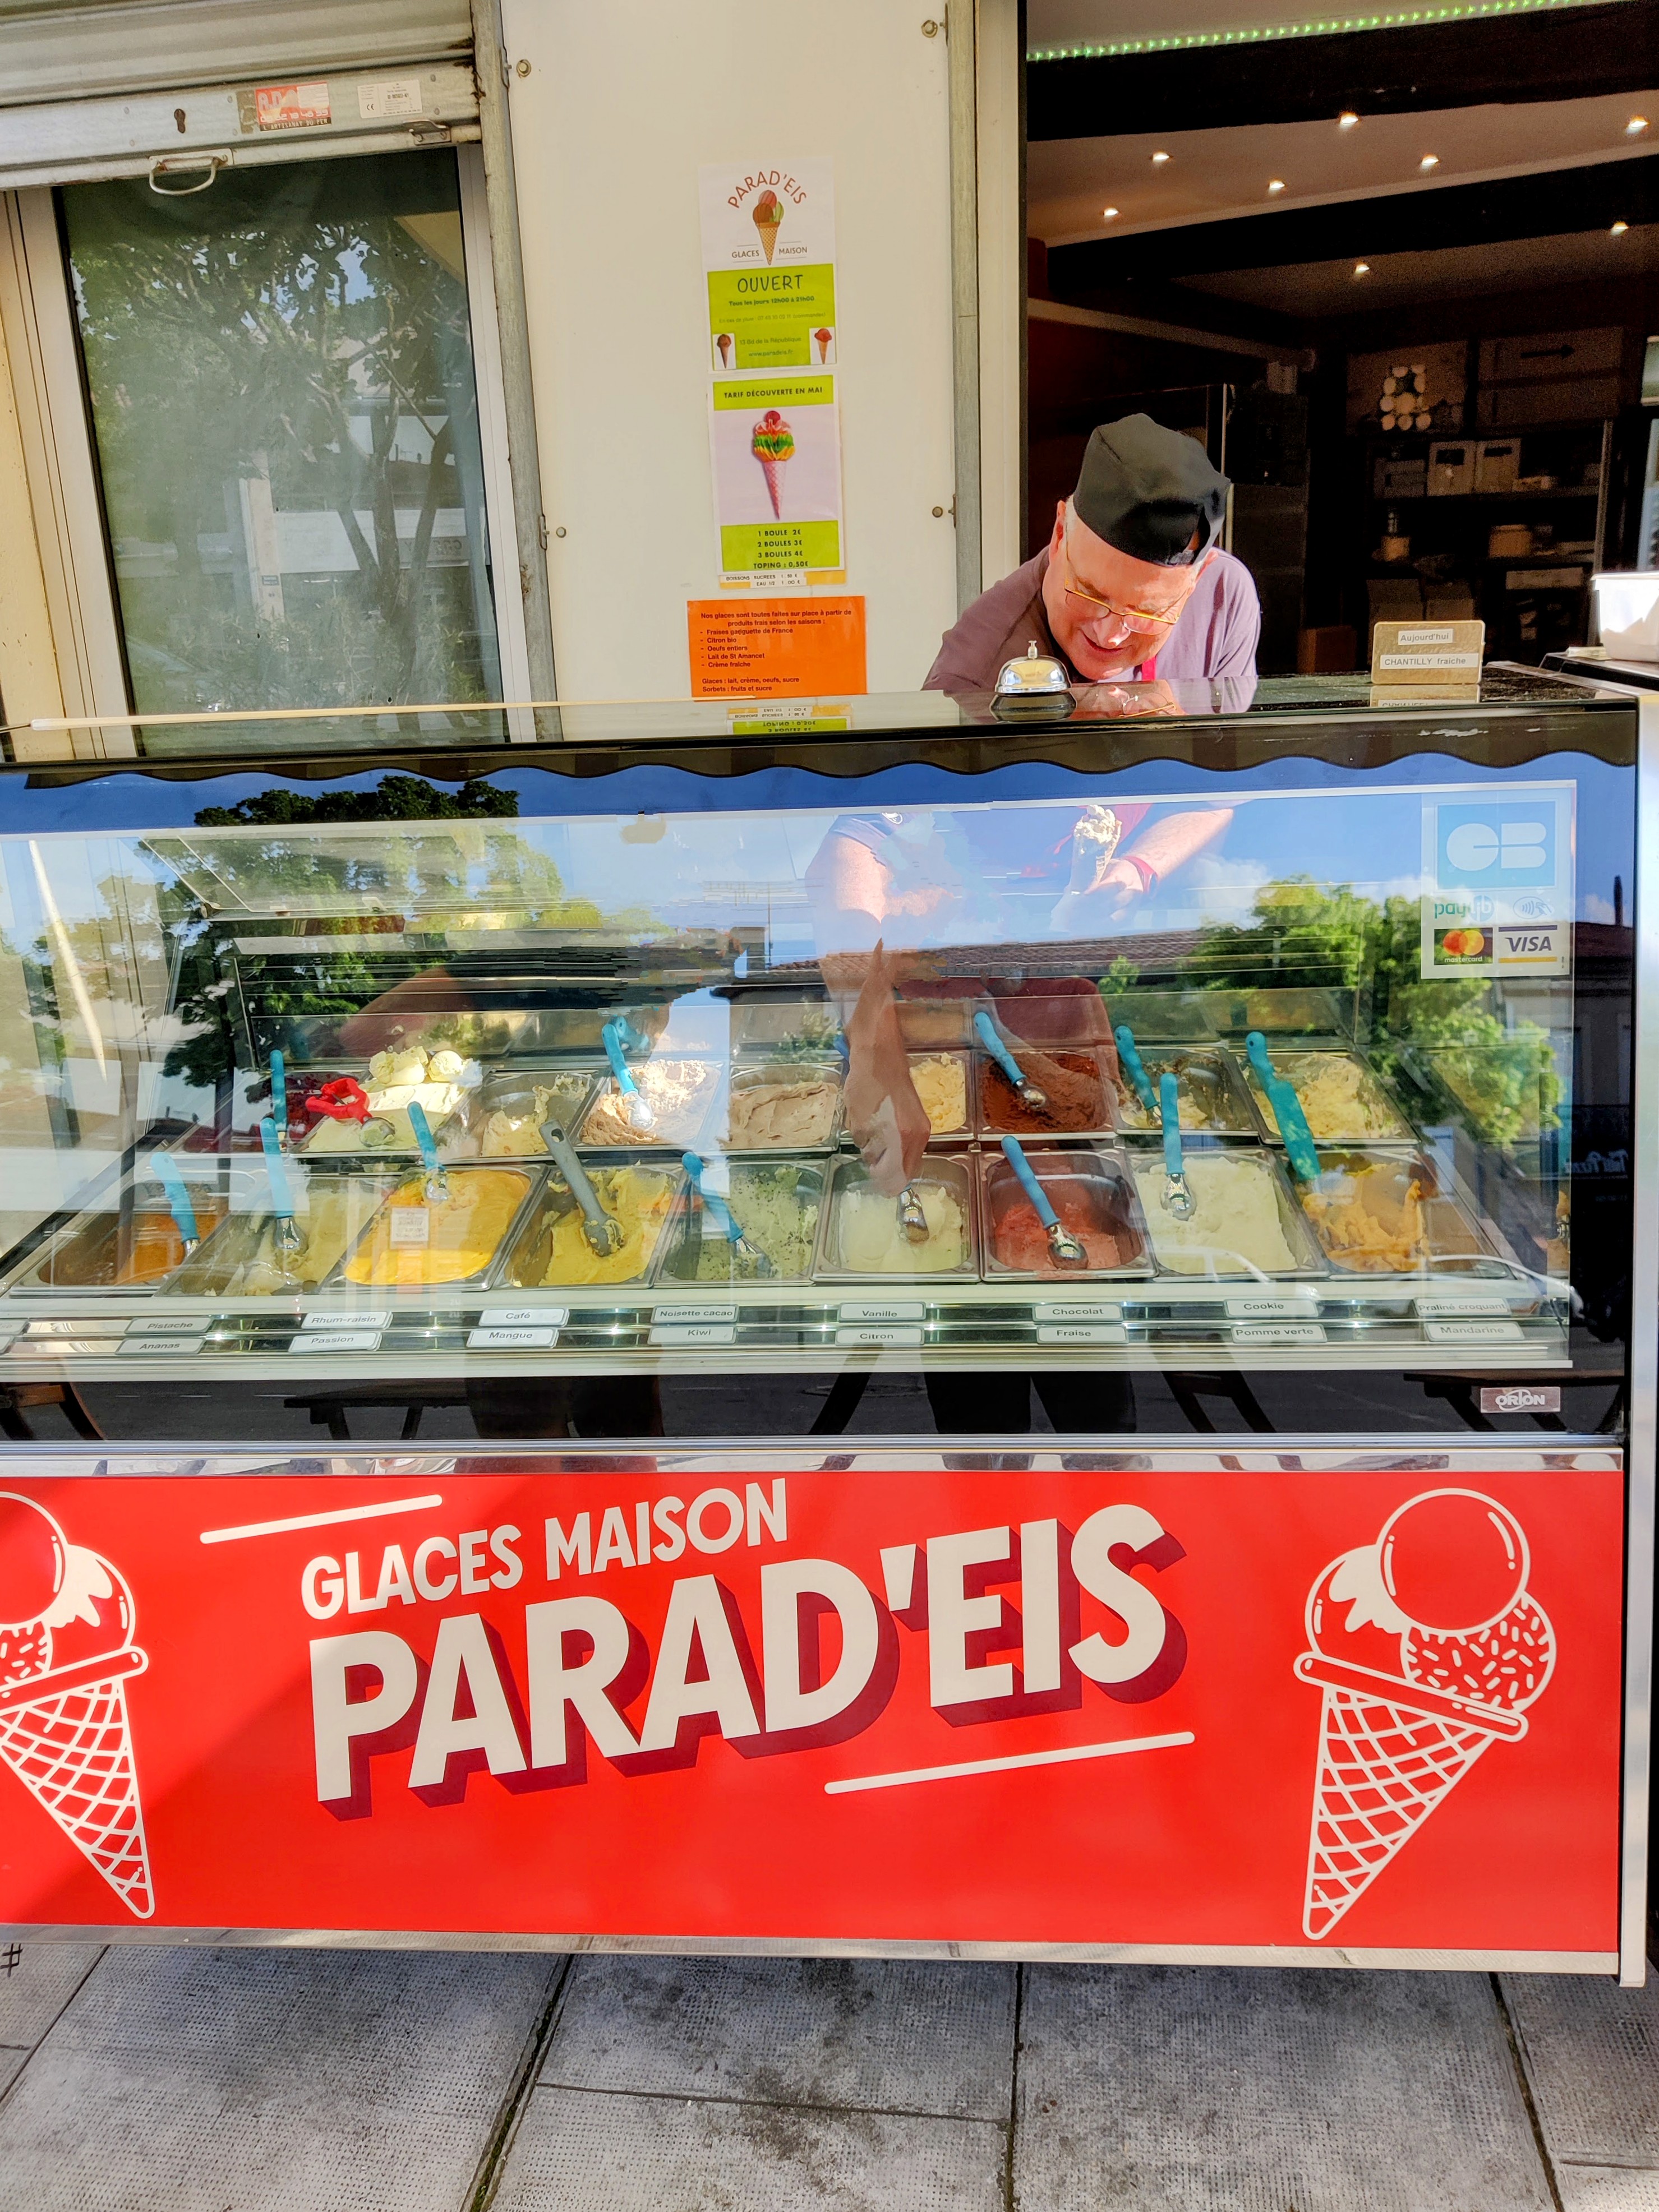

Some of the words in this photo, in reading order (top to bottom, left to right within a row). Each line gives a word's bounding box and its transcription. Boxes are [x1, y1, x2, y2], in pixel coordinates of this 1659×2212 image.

[728, 170, 807, 208] PARAD'EIS
[778, 247, 808, 255] MAISON
[738, 275, 803, 293] OUVERT
[1400, 632, 1449, 643] Aujourd'hui
[1446, 822, 1547, 871] CB
[1505, 936, 1552, 952] VISA
[1243, 1302, 1284, 1311] Cookie
[1418, 1303, 1455, 1312] Praliné
[1458, 1302, 1506, 1313] croquant
[505, 1311, 531, 1320] Café
[660, 1309, 701, 1318] Noisette
[861, 1310, 897, 1318] Vanille
[1052, 1307, 1104, 1317] Chocolat
[311, 1315, 376, 1325] Rhum-raisin
[147, 1320, 193, 1331] Pistache
[489, 1331, 533, 1341] Mangue
[687, 1328, 711, 1337] Kiwi
[1056, 1329, 1091, 1338] Fraise
[1235, 1328, 1280, 1337] Pomme
[1283, 1327, 1314, 1336] verte
[1440, 1326, 1505, 1336] Mandarine
[311, 1335, 354, 1345] Passion
[859, 1332, 893, 1341] Citron
[139, 1342, 180, 1351] Ananas
[1495, 1390, 1545, 1406] ORION
[301, 1525, 525, 1620] GLACES
[545, 1479, 789, 1581] MAISON
[308, 1503, 1169, 1805] PARAD'EIS
